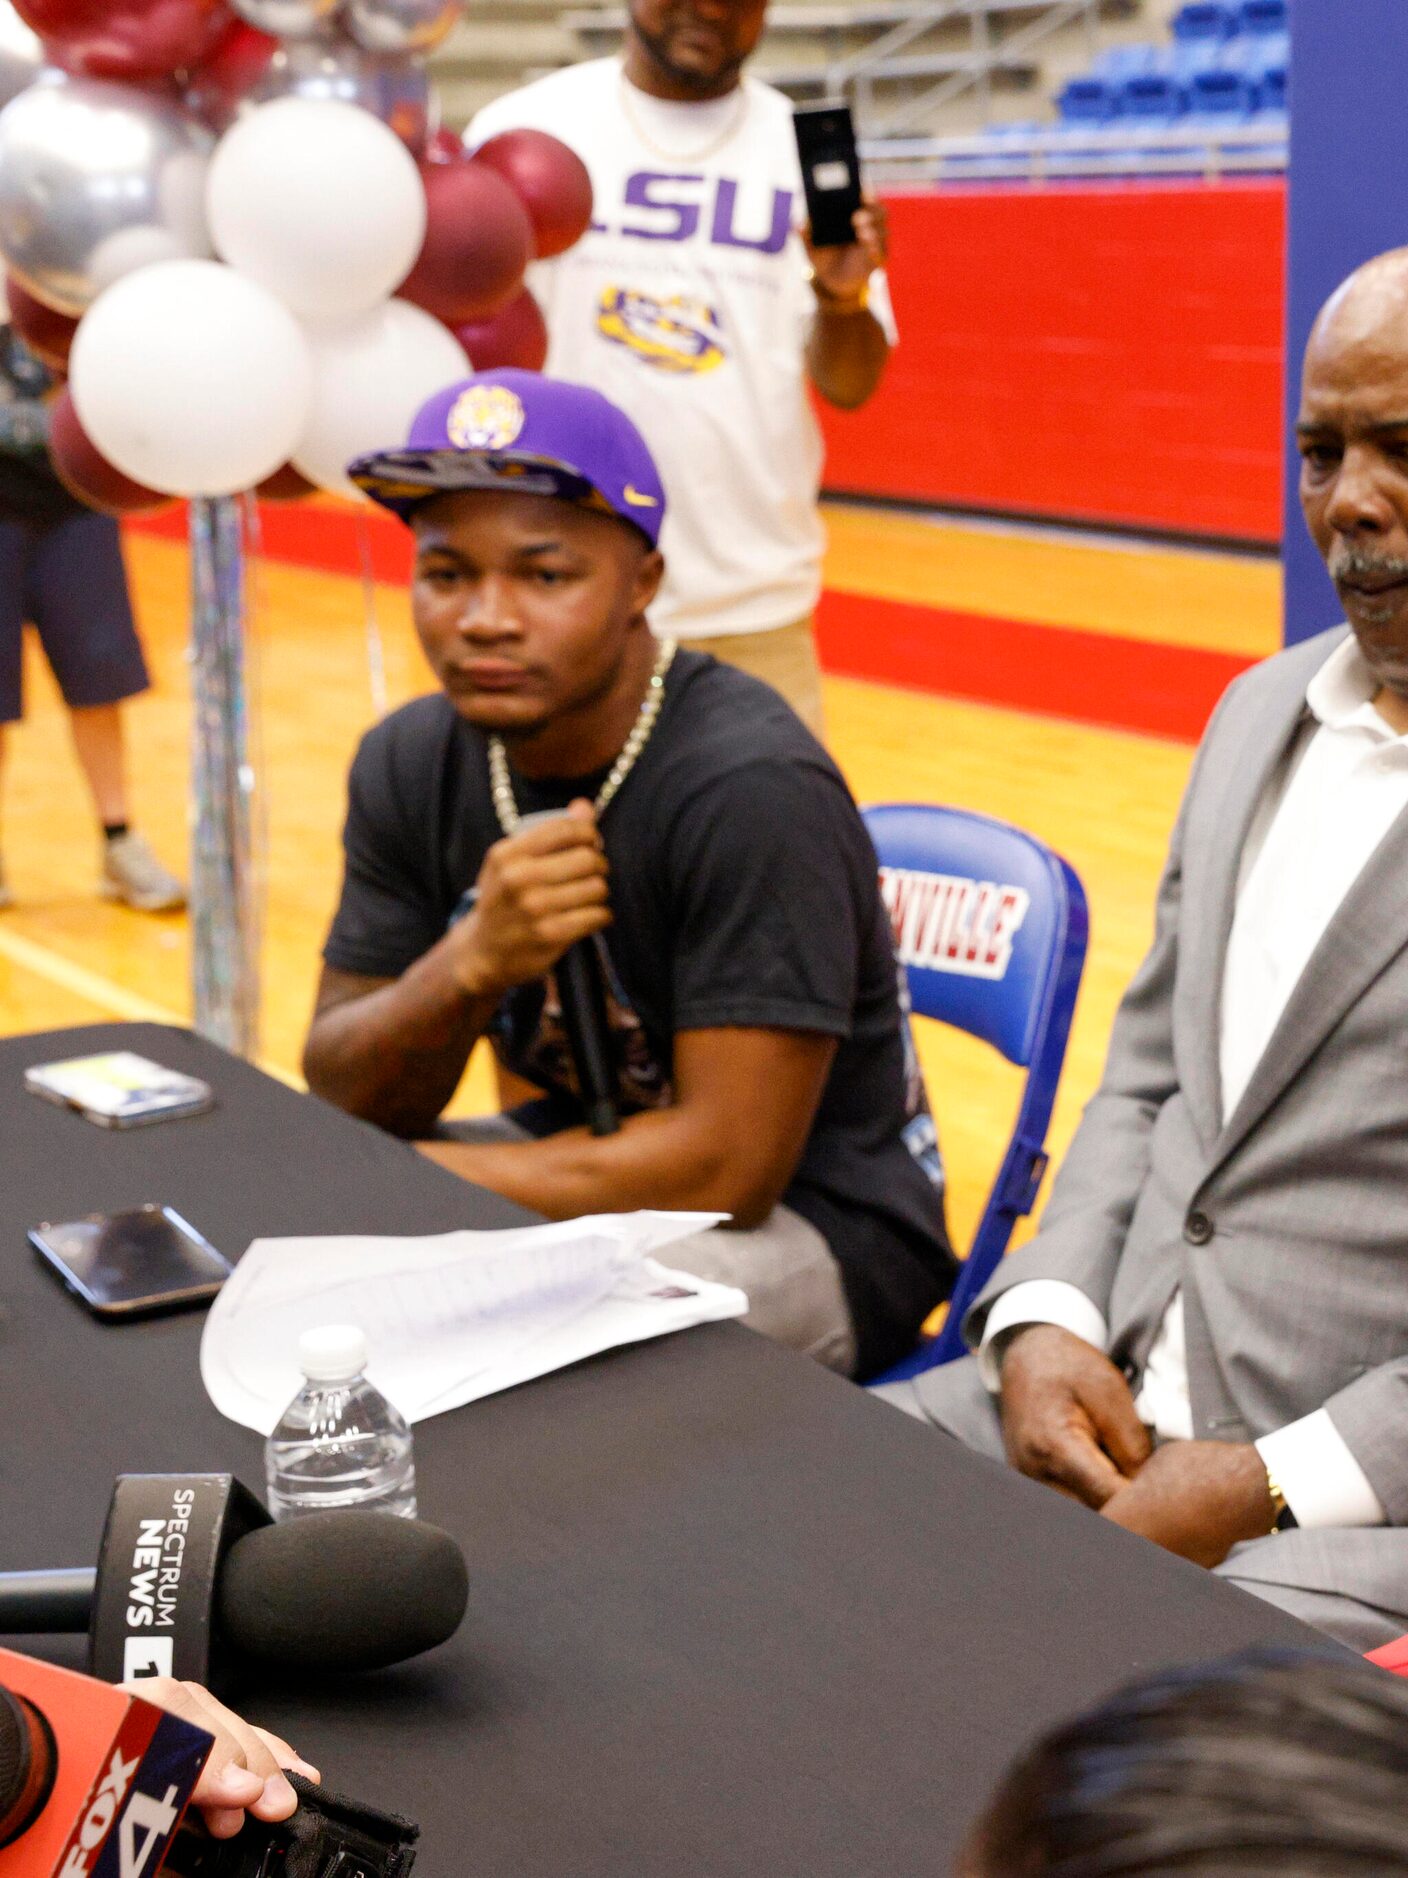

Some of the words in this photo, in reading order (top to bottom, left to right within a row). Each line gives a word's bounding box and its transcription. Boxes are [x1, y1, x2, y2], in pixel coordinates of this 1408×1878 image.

[592, 171, 793, 254] SU
[876, 868, 1028, 980] NVILLE
[126, 1519, 167, 1627] NEWS
[154, 1489, 195, 1626] SPECTRUM
[57, 1747, 141, 1878] FOX
[118, 1784, 179, 1878] 4
